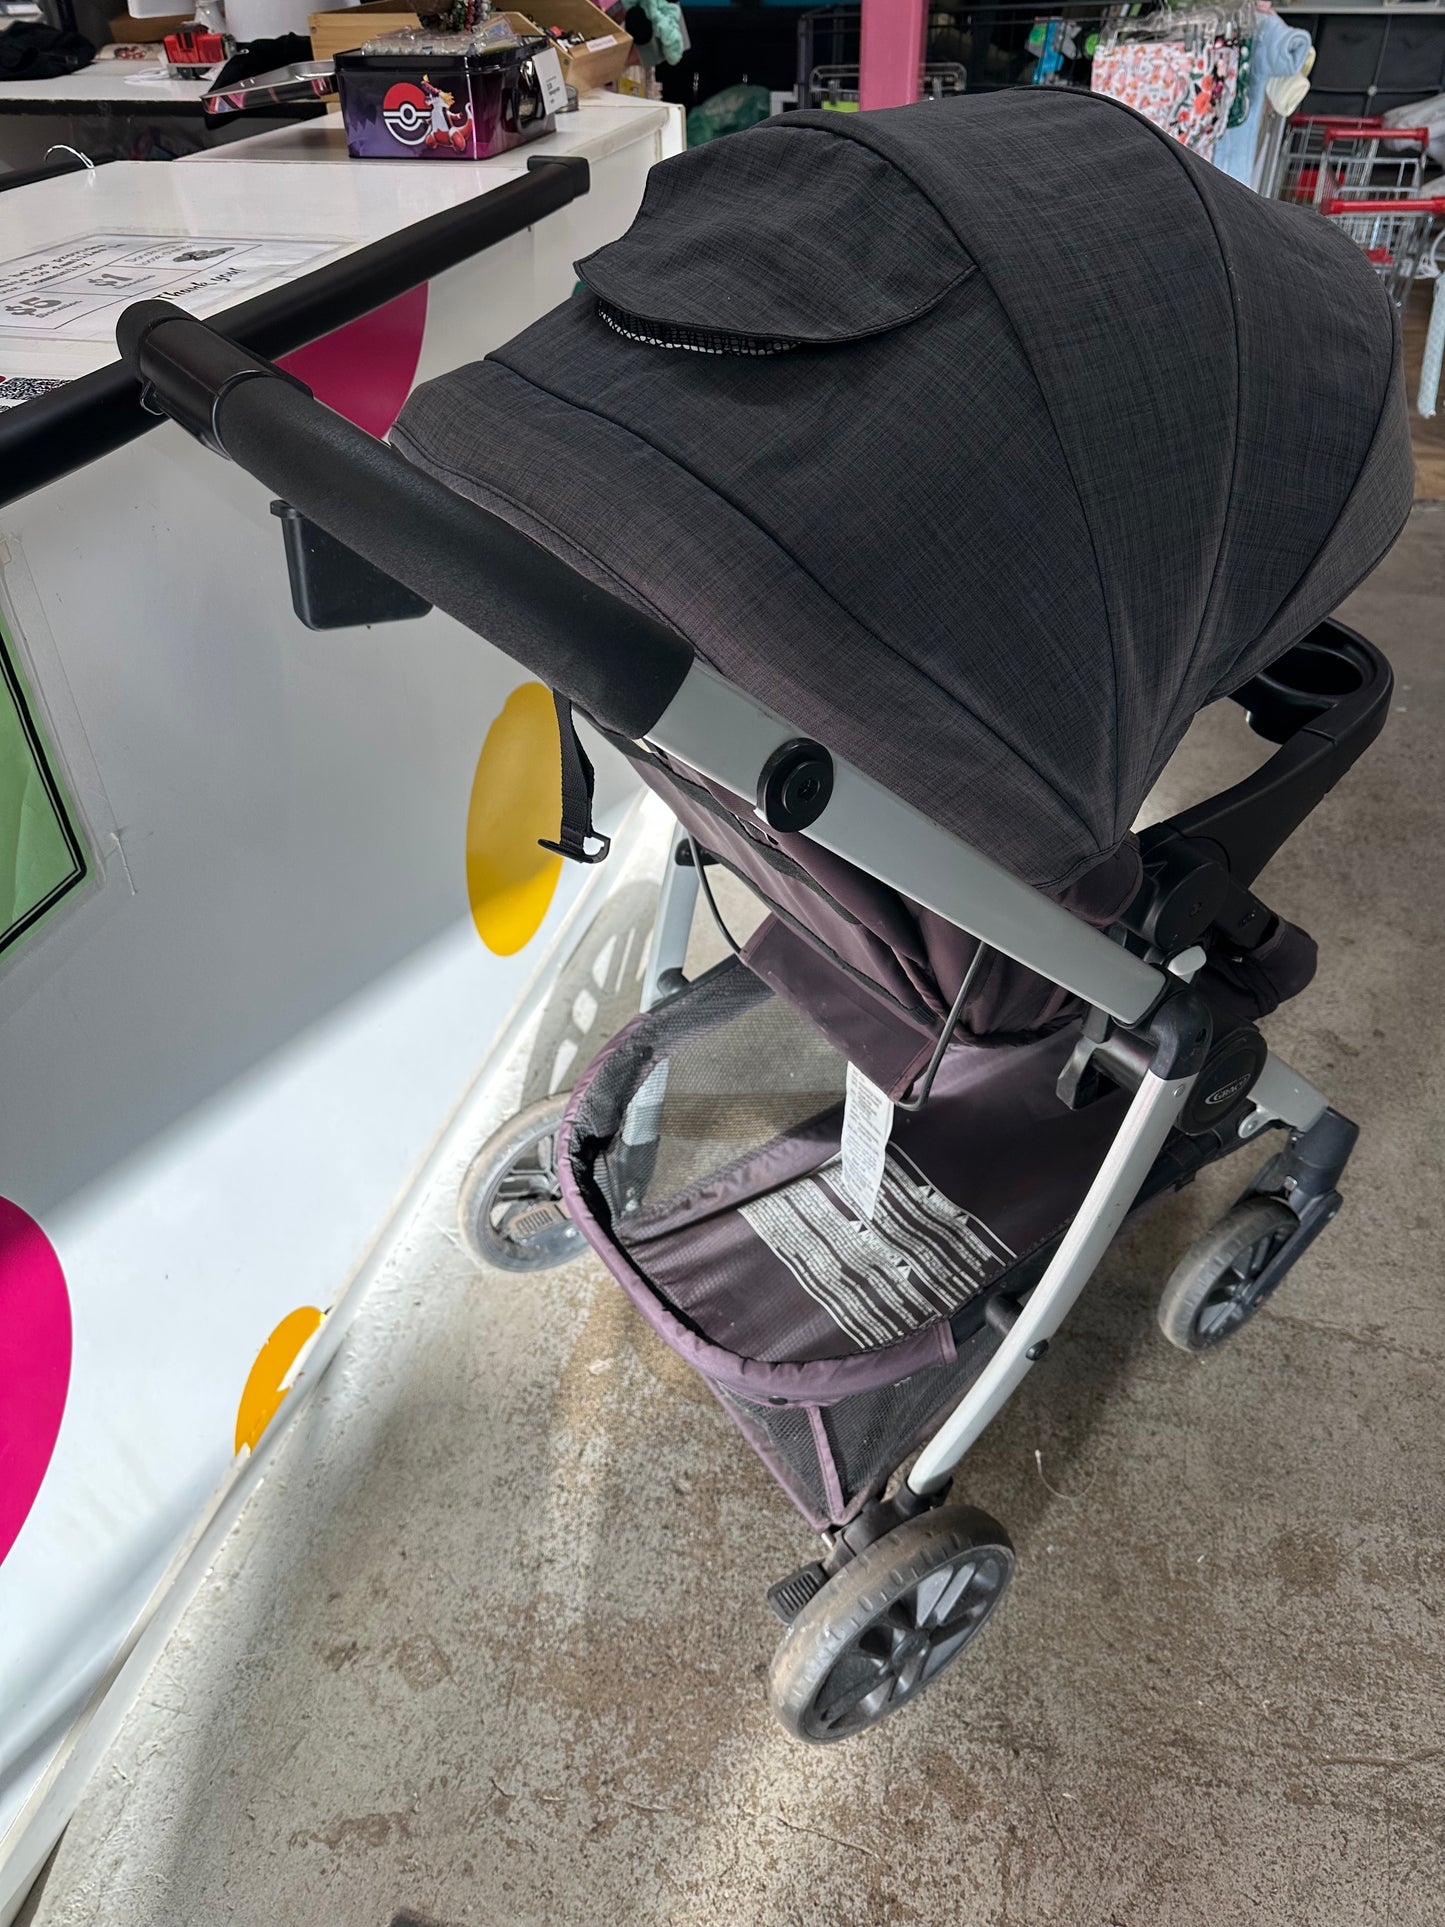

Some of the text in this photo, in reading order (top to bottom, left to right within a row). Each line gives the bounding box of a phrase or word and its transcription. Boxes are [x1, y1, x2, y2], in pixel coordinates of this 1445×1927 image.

[87, 273, 134, 287] $1
[150, 281, 217, 300] Thank
[5, 296, 62, 316] $5
